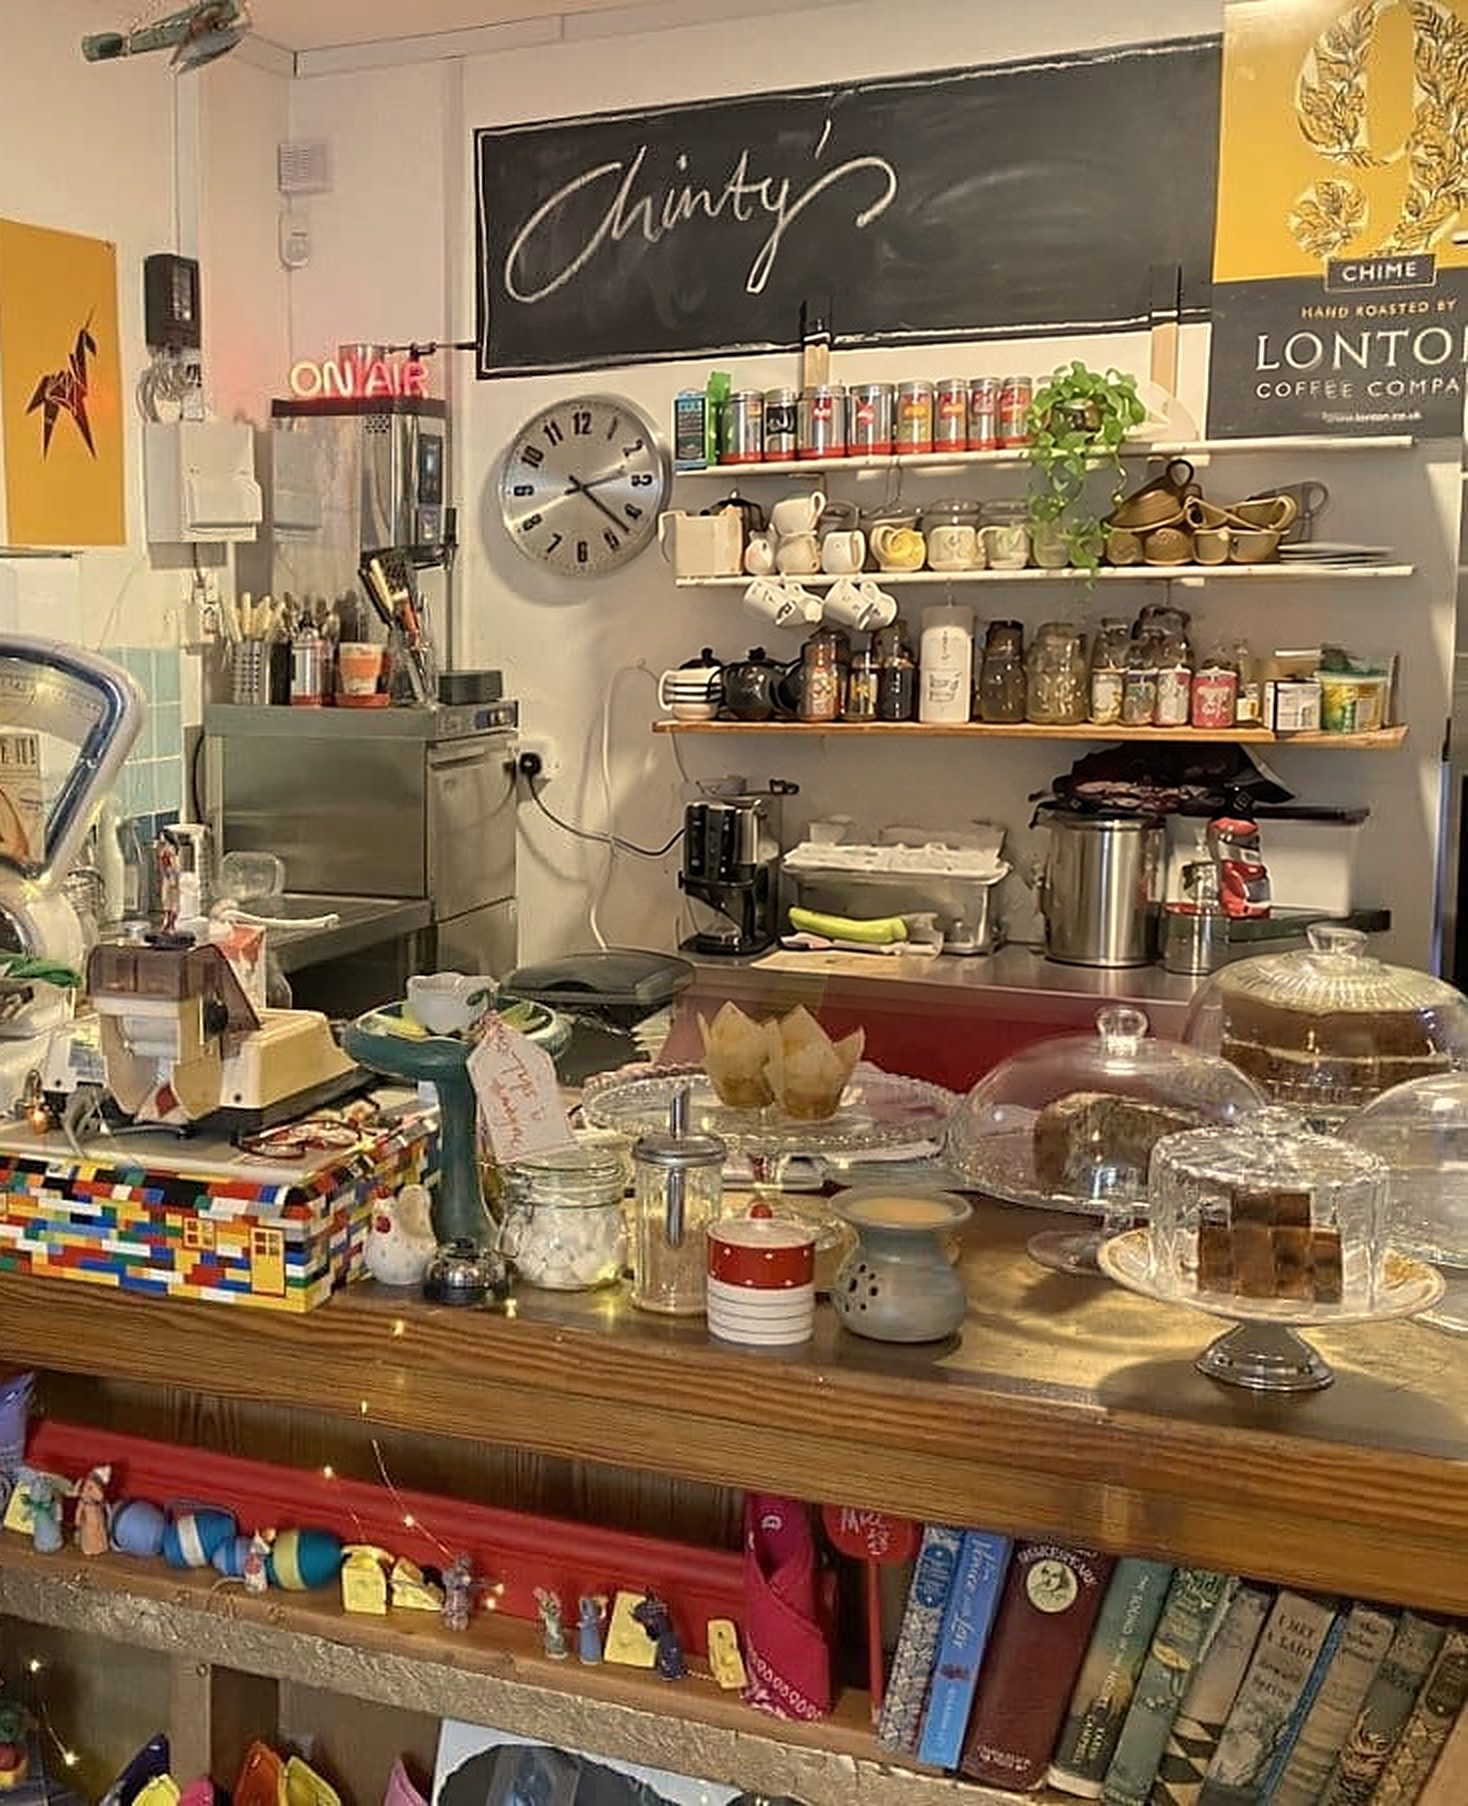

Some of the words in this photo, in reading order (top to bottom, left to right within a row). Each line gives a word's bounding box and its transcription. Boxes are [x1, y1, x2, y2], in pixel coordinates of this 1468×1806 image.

[1341, 260, 1418, 282] CHIME
[1301, 304, 1349, 320] HAND
[1355, 300, 1429, 318] ROASTED
[1437, 298, 1458, 312] BY
[1256, 325, 1468, 370] LONTO
[290, 360, 354, 398] ON
[364, 360, 429, 399] AIR
[1256, 379, 1353, 400] COFFEE
[543, 421, 564, 446] 11
[573, 412, 592, 435] 12
[521, 445, 545, 469] 10
[622, 439, 644, 458] 2
[546, 533, 563, 553] 7
